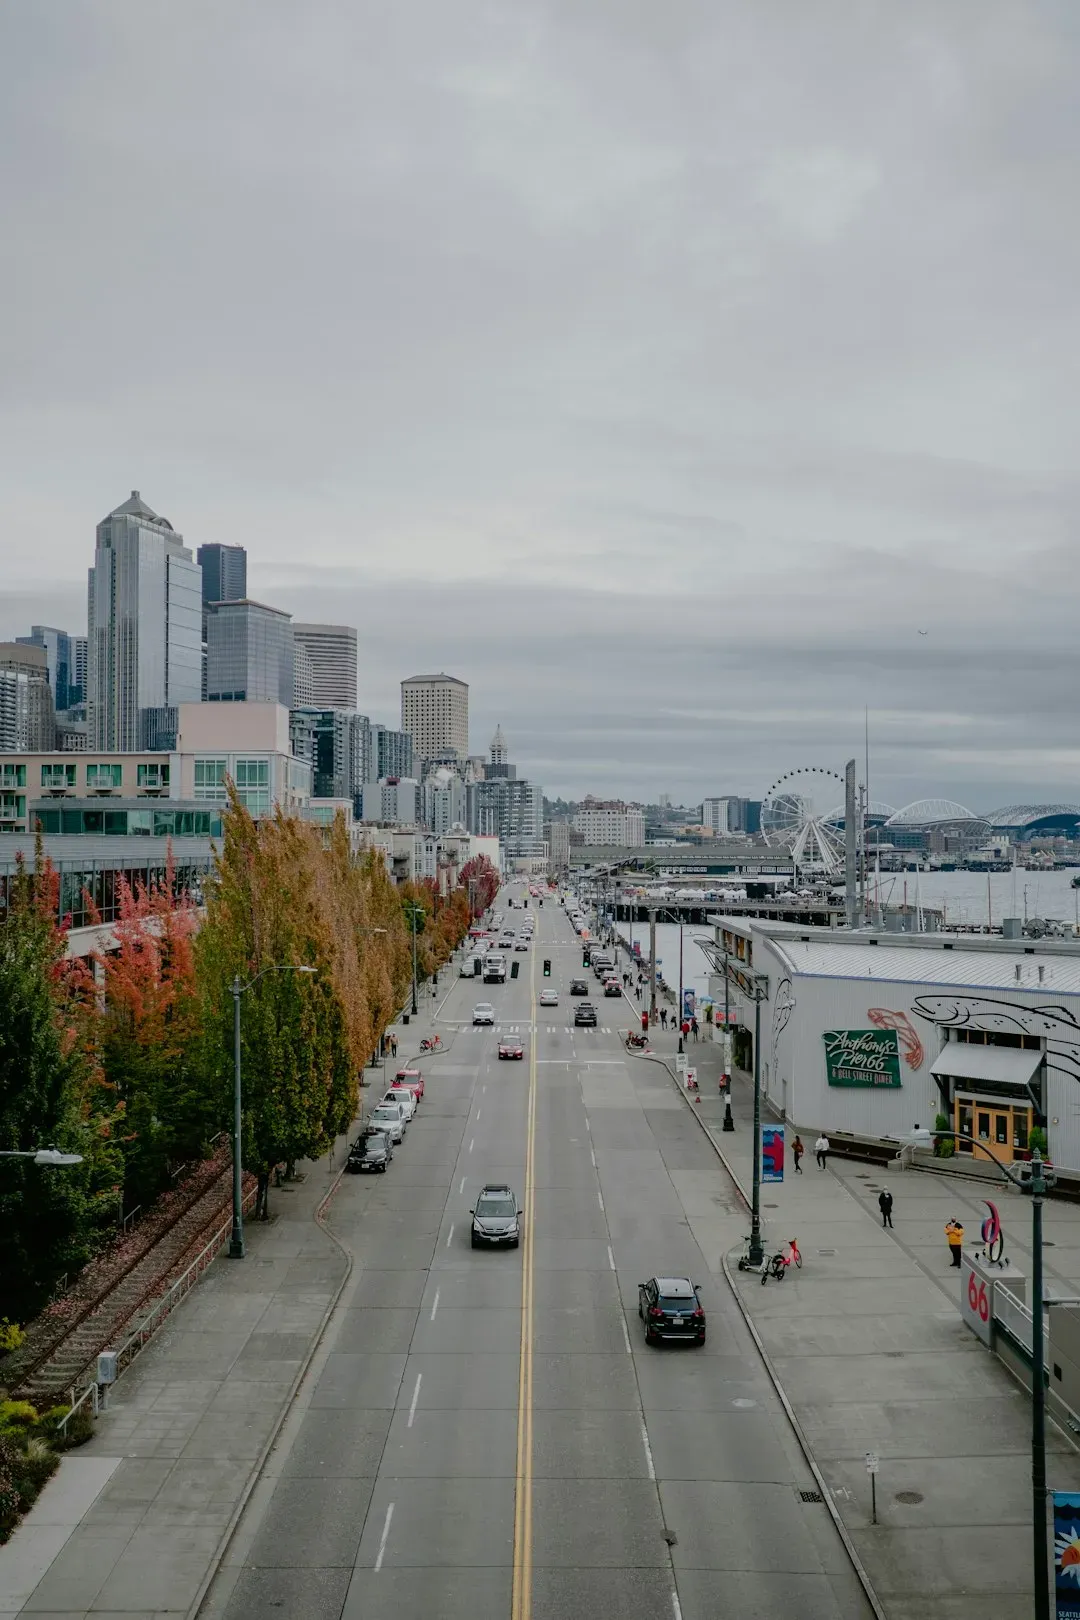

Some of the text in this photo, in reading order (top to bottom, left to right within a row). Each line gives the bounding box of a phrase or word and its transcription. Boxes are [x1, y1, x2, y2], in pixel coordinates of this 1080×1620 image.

[822, 1031, 898, 1057] Anthony's
[829, 1048, 889, 1071] Pier 66
[852, 1070, 873, 1082] STREET
[874, 1072, 893, 1085] DINER
[968, 1270, 989, 1322] 66
[1058, 1610, 1080, 1619] SEATTL
